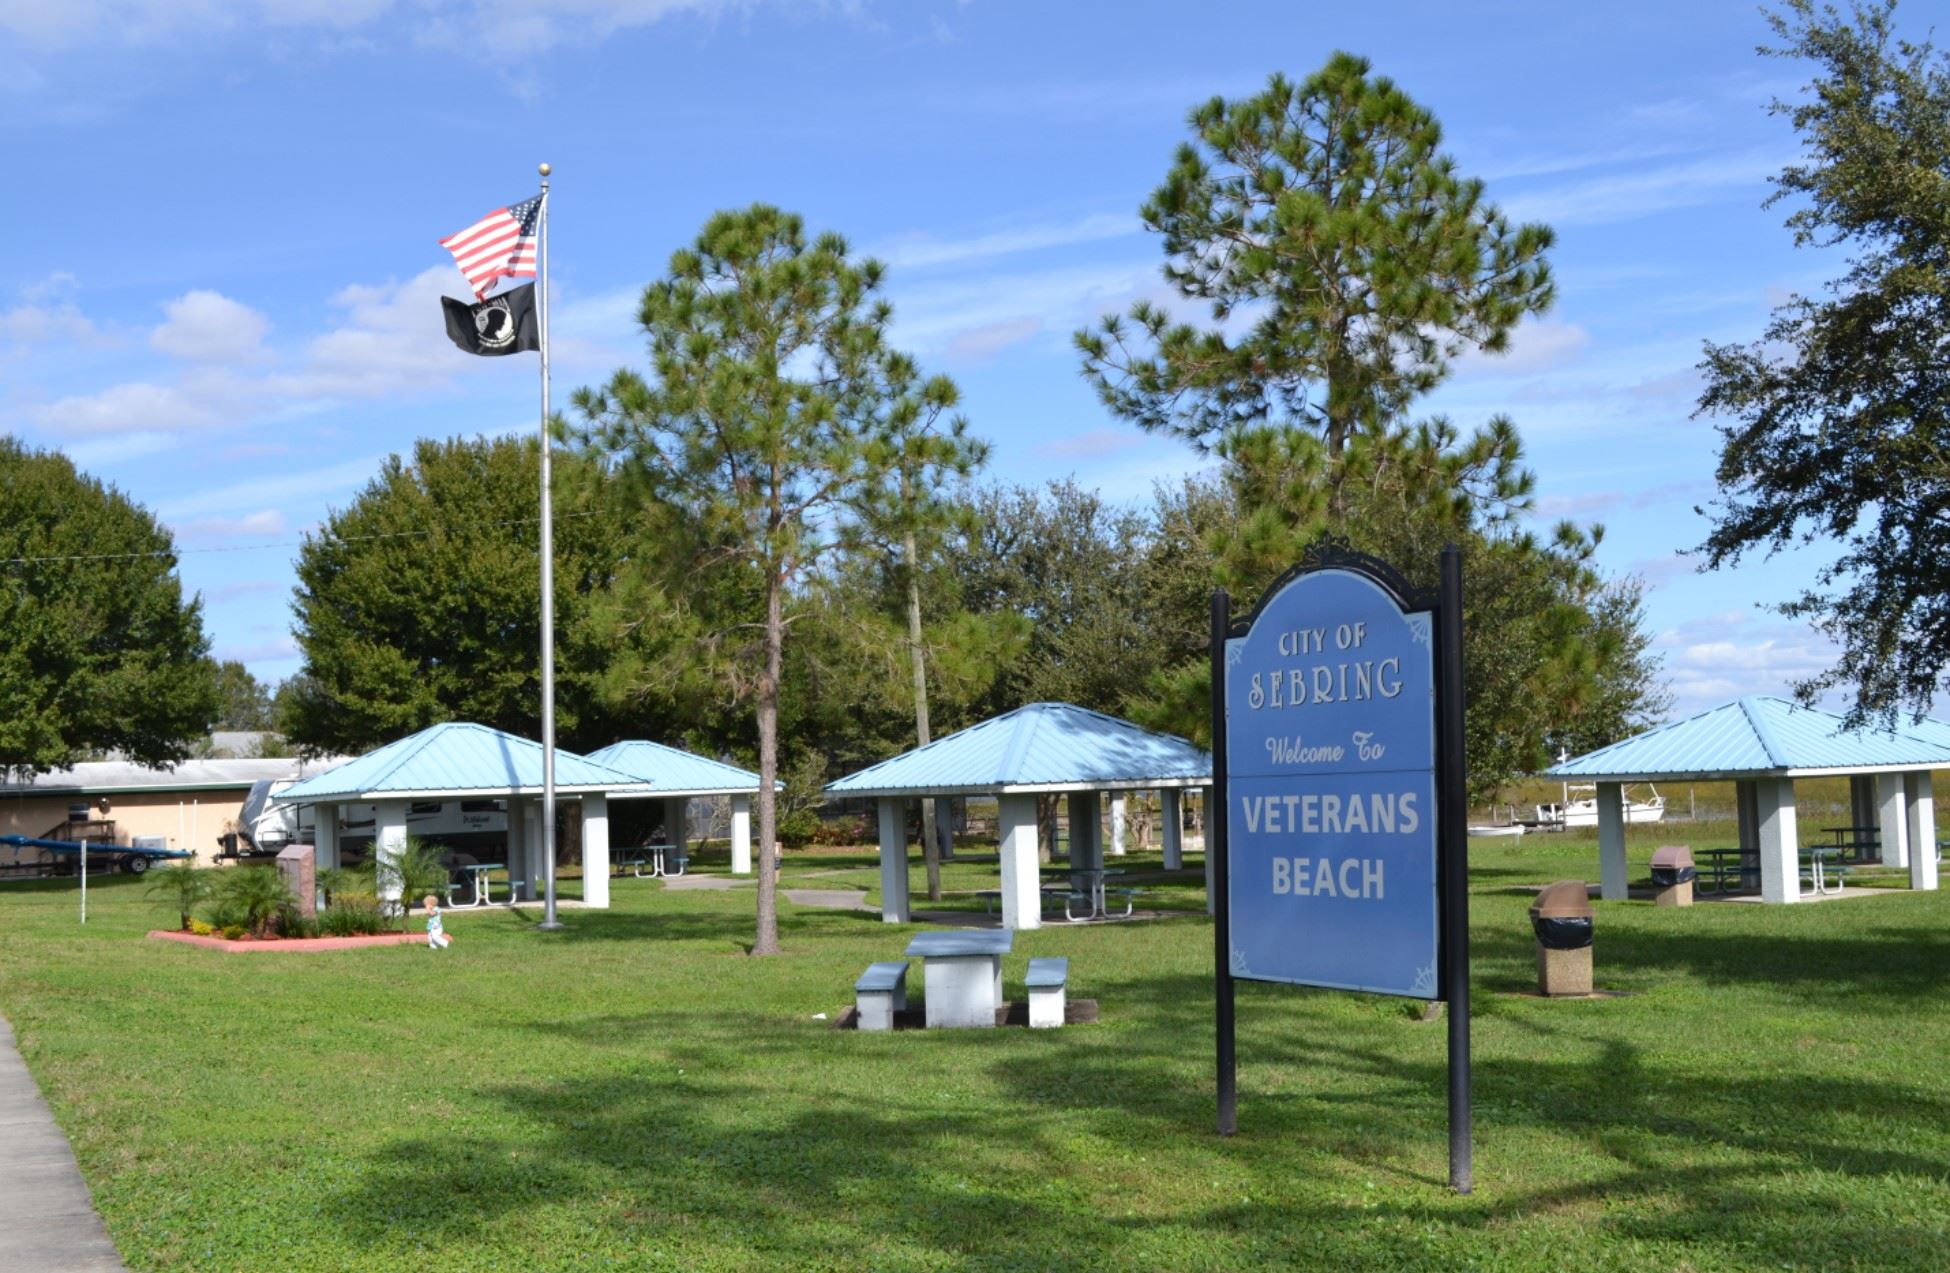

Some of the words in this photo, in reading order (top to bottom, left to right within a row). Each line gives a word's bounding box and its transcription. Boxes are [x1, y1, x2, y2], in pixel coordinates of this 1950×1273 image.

[1279, 628, 1325, 656] CITY
[1336, 622, 1366, 648] OF
[1248, 656, 1403, 710] SEBRING
[1265, 736, 1344, 764] Welcome
[1352, 731, 1385, 761] To
[1242, 792, 1419, 833] VETERANS
[1272, 857, 1384, 899] BEACH
